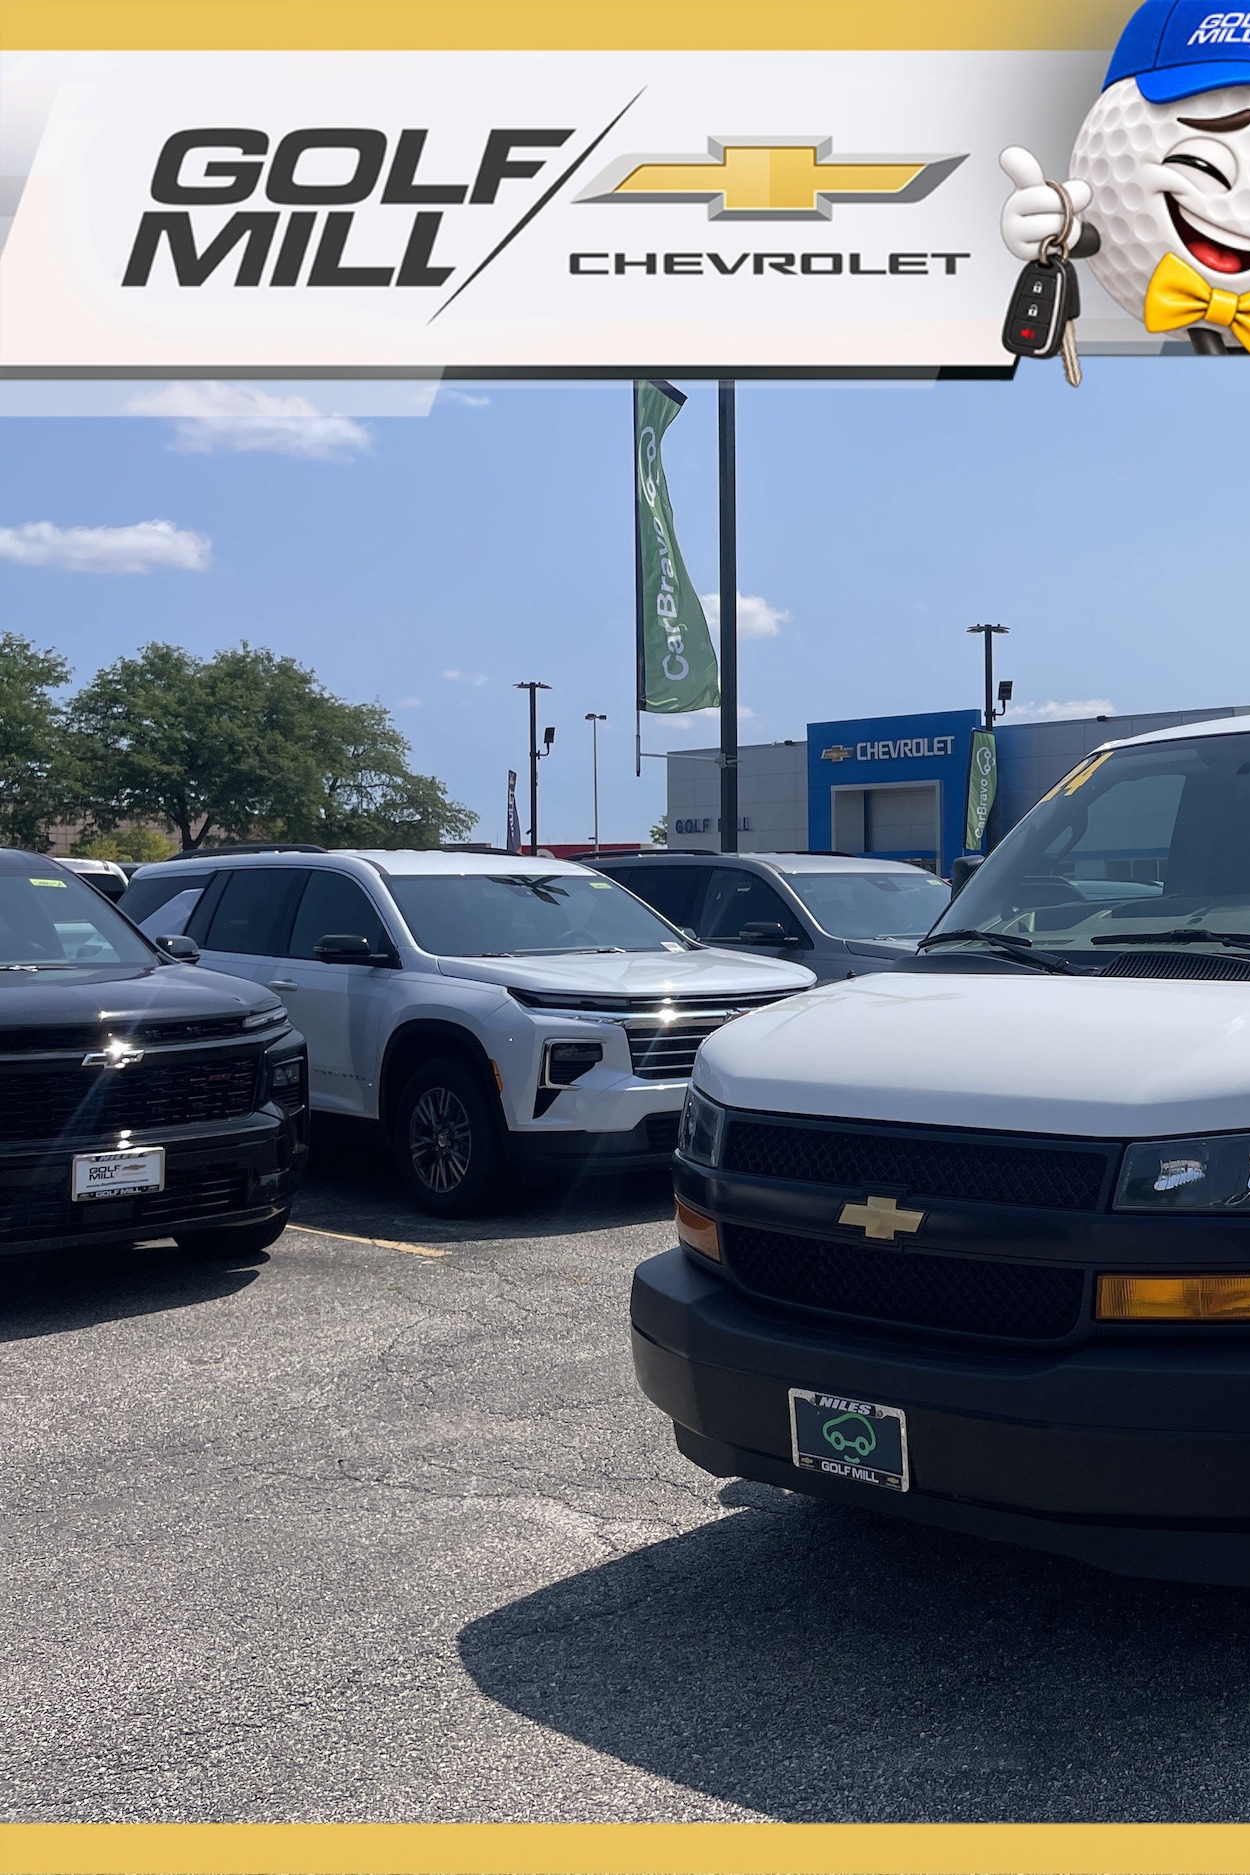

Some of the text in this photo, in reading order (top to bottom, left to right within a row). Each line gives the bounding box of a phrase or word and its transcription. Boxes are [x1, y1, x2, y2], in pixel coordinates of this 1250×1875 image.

[656, 517, 690, 681] CarBravo
[856, 735, 955, 761] CHEVROLET
[974, 778, 989, 839] CarBravo
[675, 818, 710, 834] GOLF
[89, 1164, 121, 1174] GOLF
[89, 1172, 115, 1181] MILL
[95, 1186, 142, 1198] GOLF MILL
[819, 1396, 872, 1416] NILES
[821, 1460, 880, 1483] GOLF MILL
